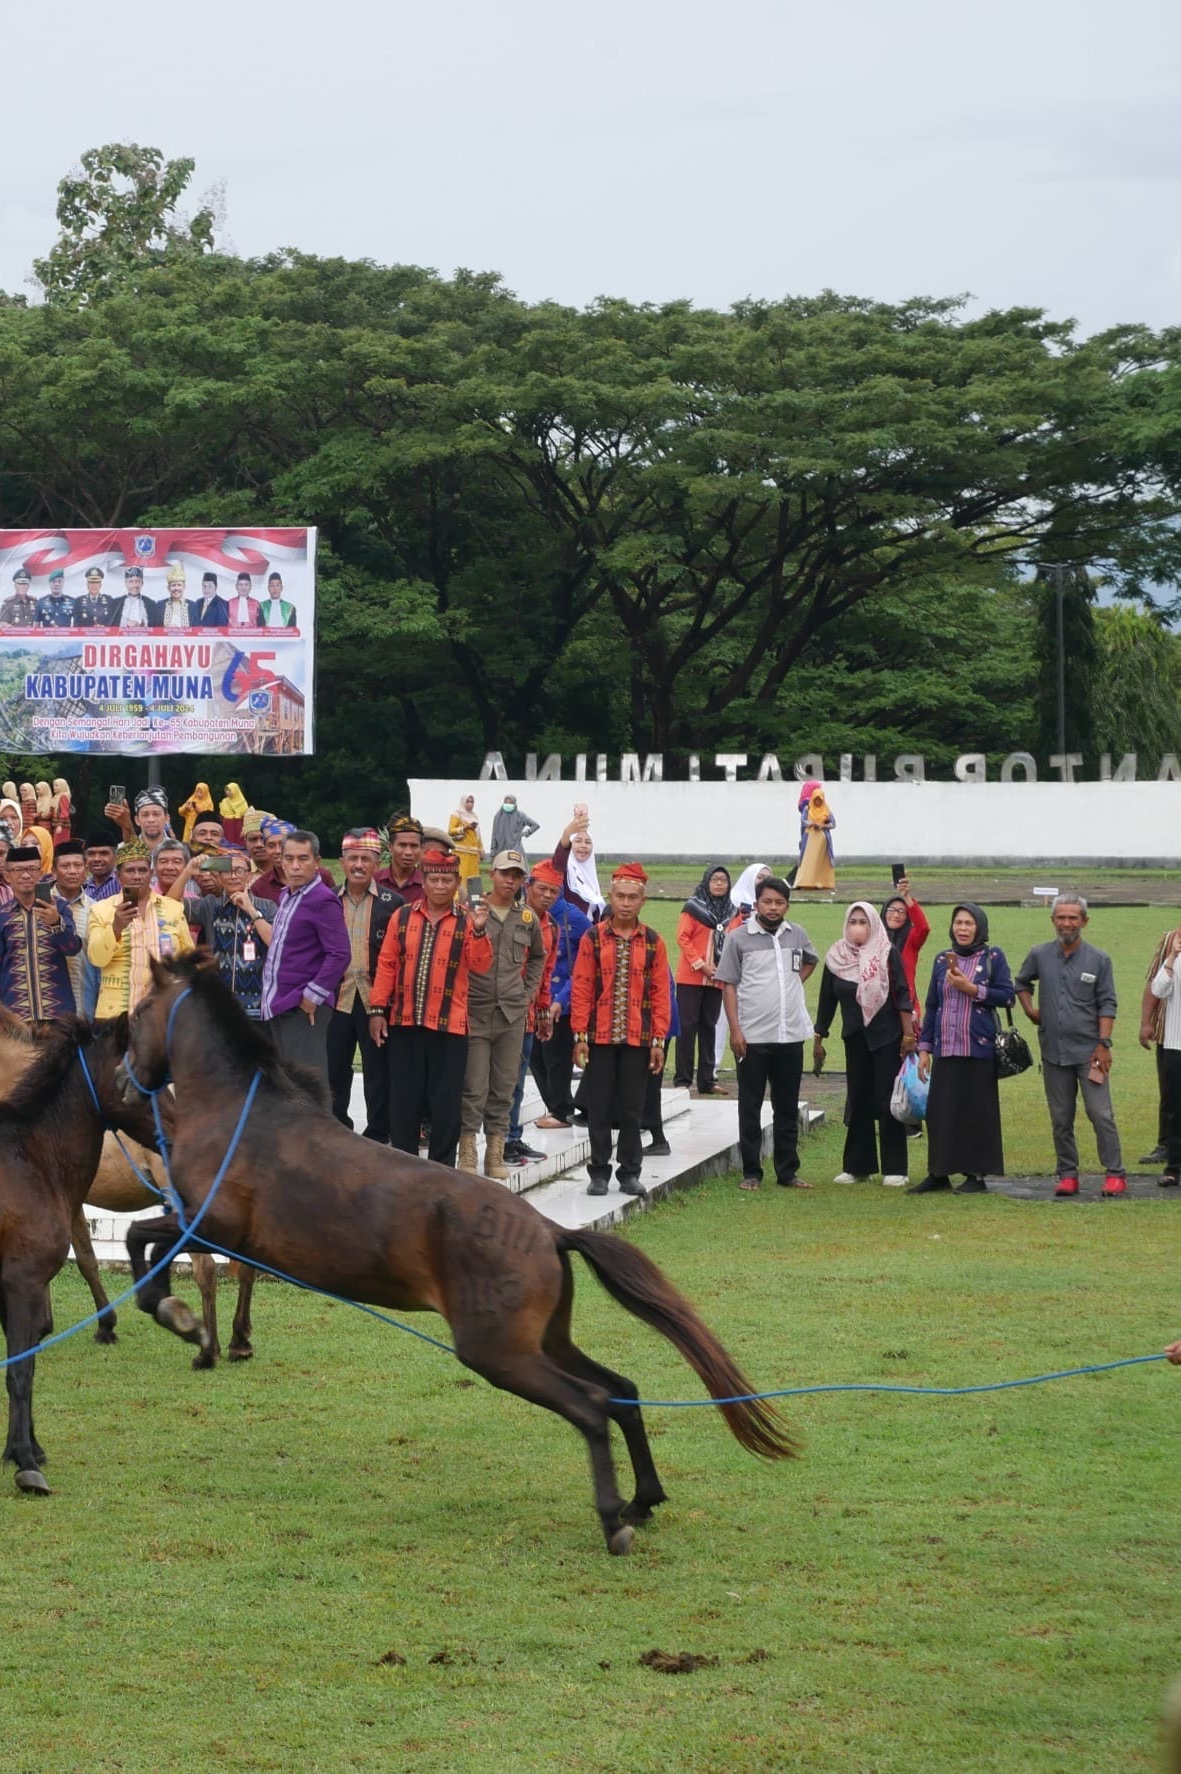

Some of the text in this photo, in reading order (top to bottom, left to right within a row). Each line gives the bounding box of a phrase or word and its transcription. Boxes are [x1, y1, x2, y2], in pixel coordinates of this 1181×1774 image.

[83, 643, 212, 669] DIRGAHAYU
[25, 674, 213, 699] KABUPATEN MUNA
[33, 717, 66, 729] Dengan
[67, 717, 111, 729] Semangat
[112, 717, 129, 727] Hari
[182, 718, 230, 730] Kabupaten
[232, 719, 255, 729] Muna
[50, 729, 67, 740] Kita
[68, 729, 110, 741] Wujudkan
[173, 731, 236, 742] Pembangunan
